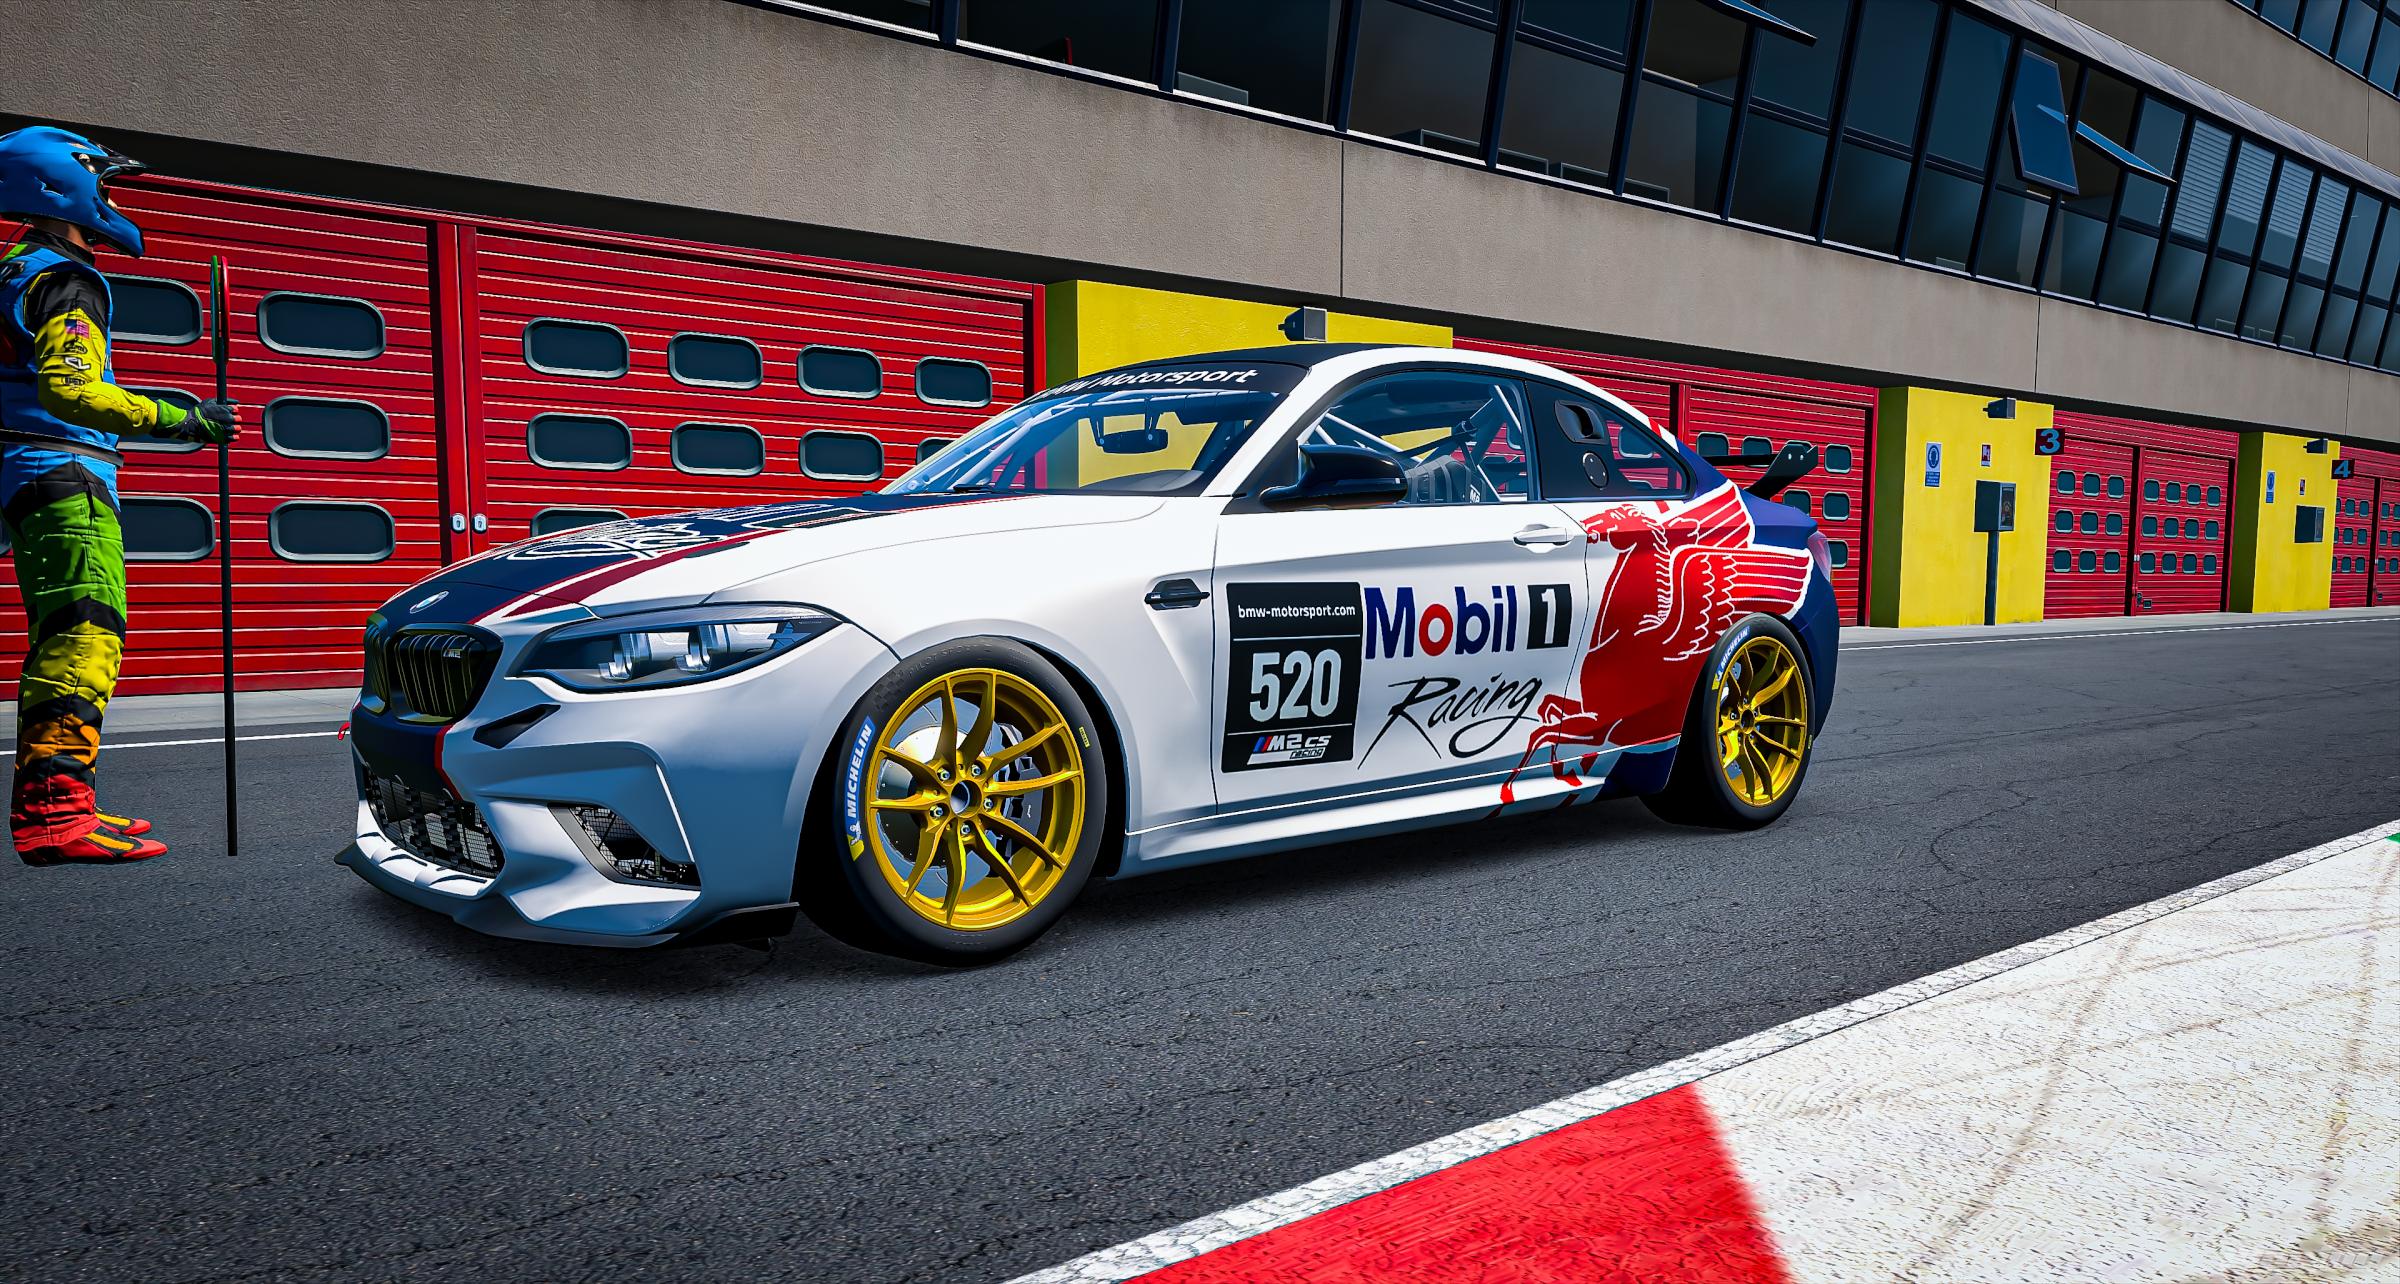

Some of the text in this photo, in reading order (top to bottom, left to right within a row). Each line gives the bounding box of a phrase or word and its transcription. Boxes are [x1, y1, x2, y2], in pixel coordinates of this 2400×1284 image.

[1088, 369, 1259, 388] Motorsport
[2040, 428, 2060, 453] 3
[2334, 460, 2351, 477] 4
[1238, 604, 1356, 619] bmw-motorsport.com
[1364, 585, 1557, 660] Mobil 1
[1720, 628, 1748, 669] MICHELIN
[1249, 648, 1341, 722] 520
[1357, 672, 1543, 770] Racing
[847, 724, 872, 818] MICHELIN
